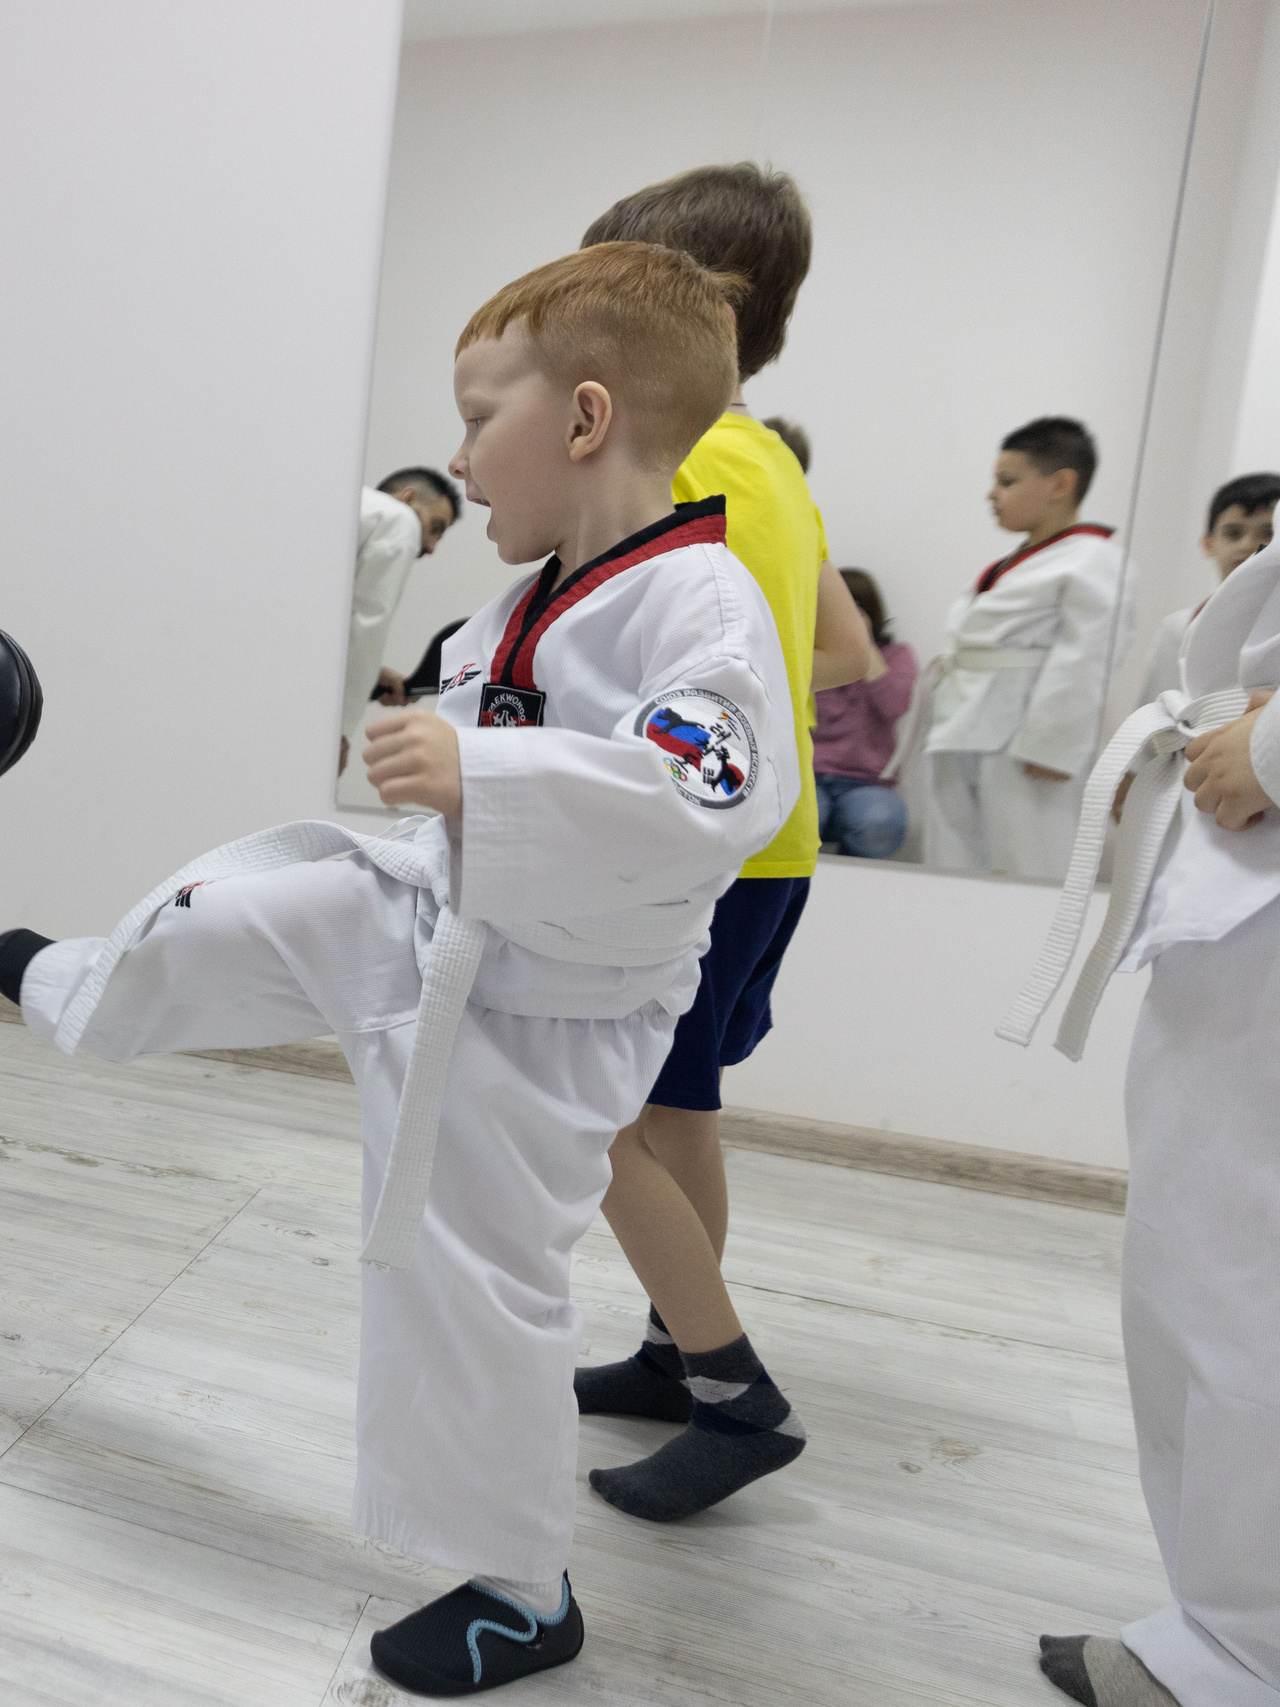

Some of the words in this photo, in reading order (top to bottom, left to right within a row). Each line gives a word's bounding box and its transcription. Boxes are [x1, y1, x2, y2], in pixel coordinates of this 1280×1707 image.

[487, 692, 527, 722] TAEKWONDO
[655, 690, 682, 705] СОЮЗ
[683, 689, 737, 713] РАЗВИТИЯ
[734, 711, 757, 752] БОЕВЫХ
